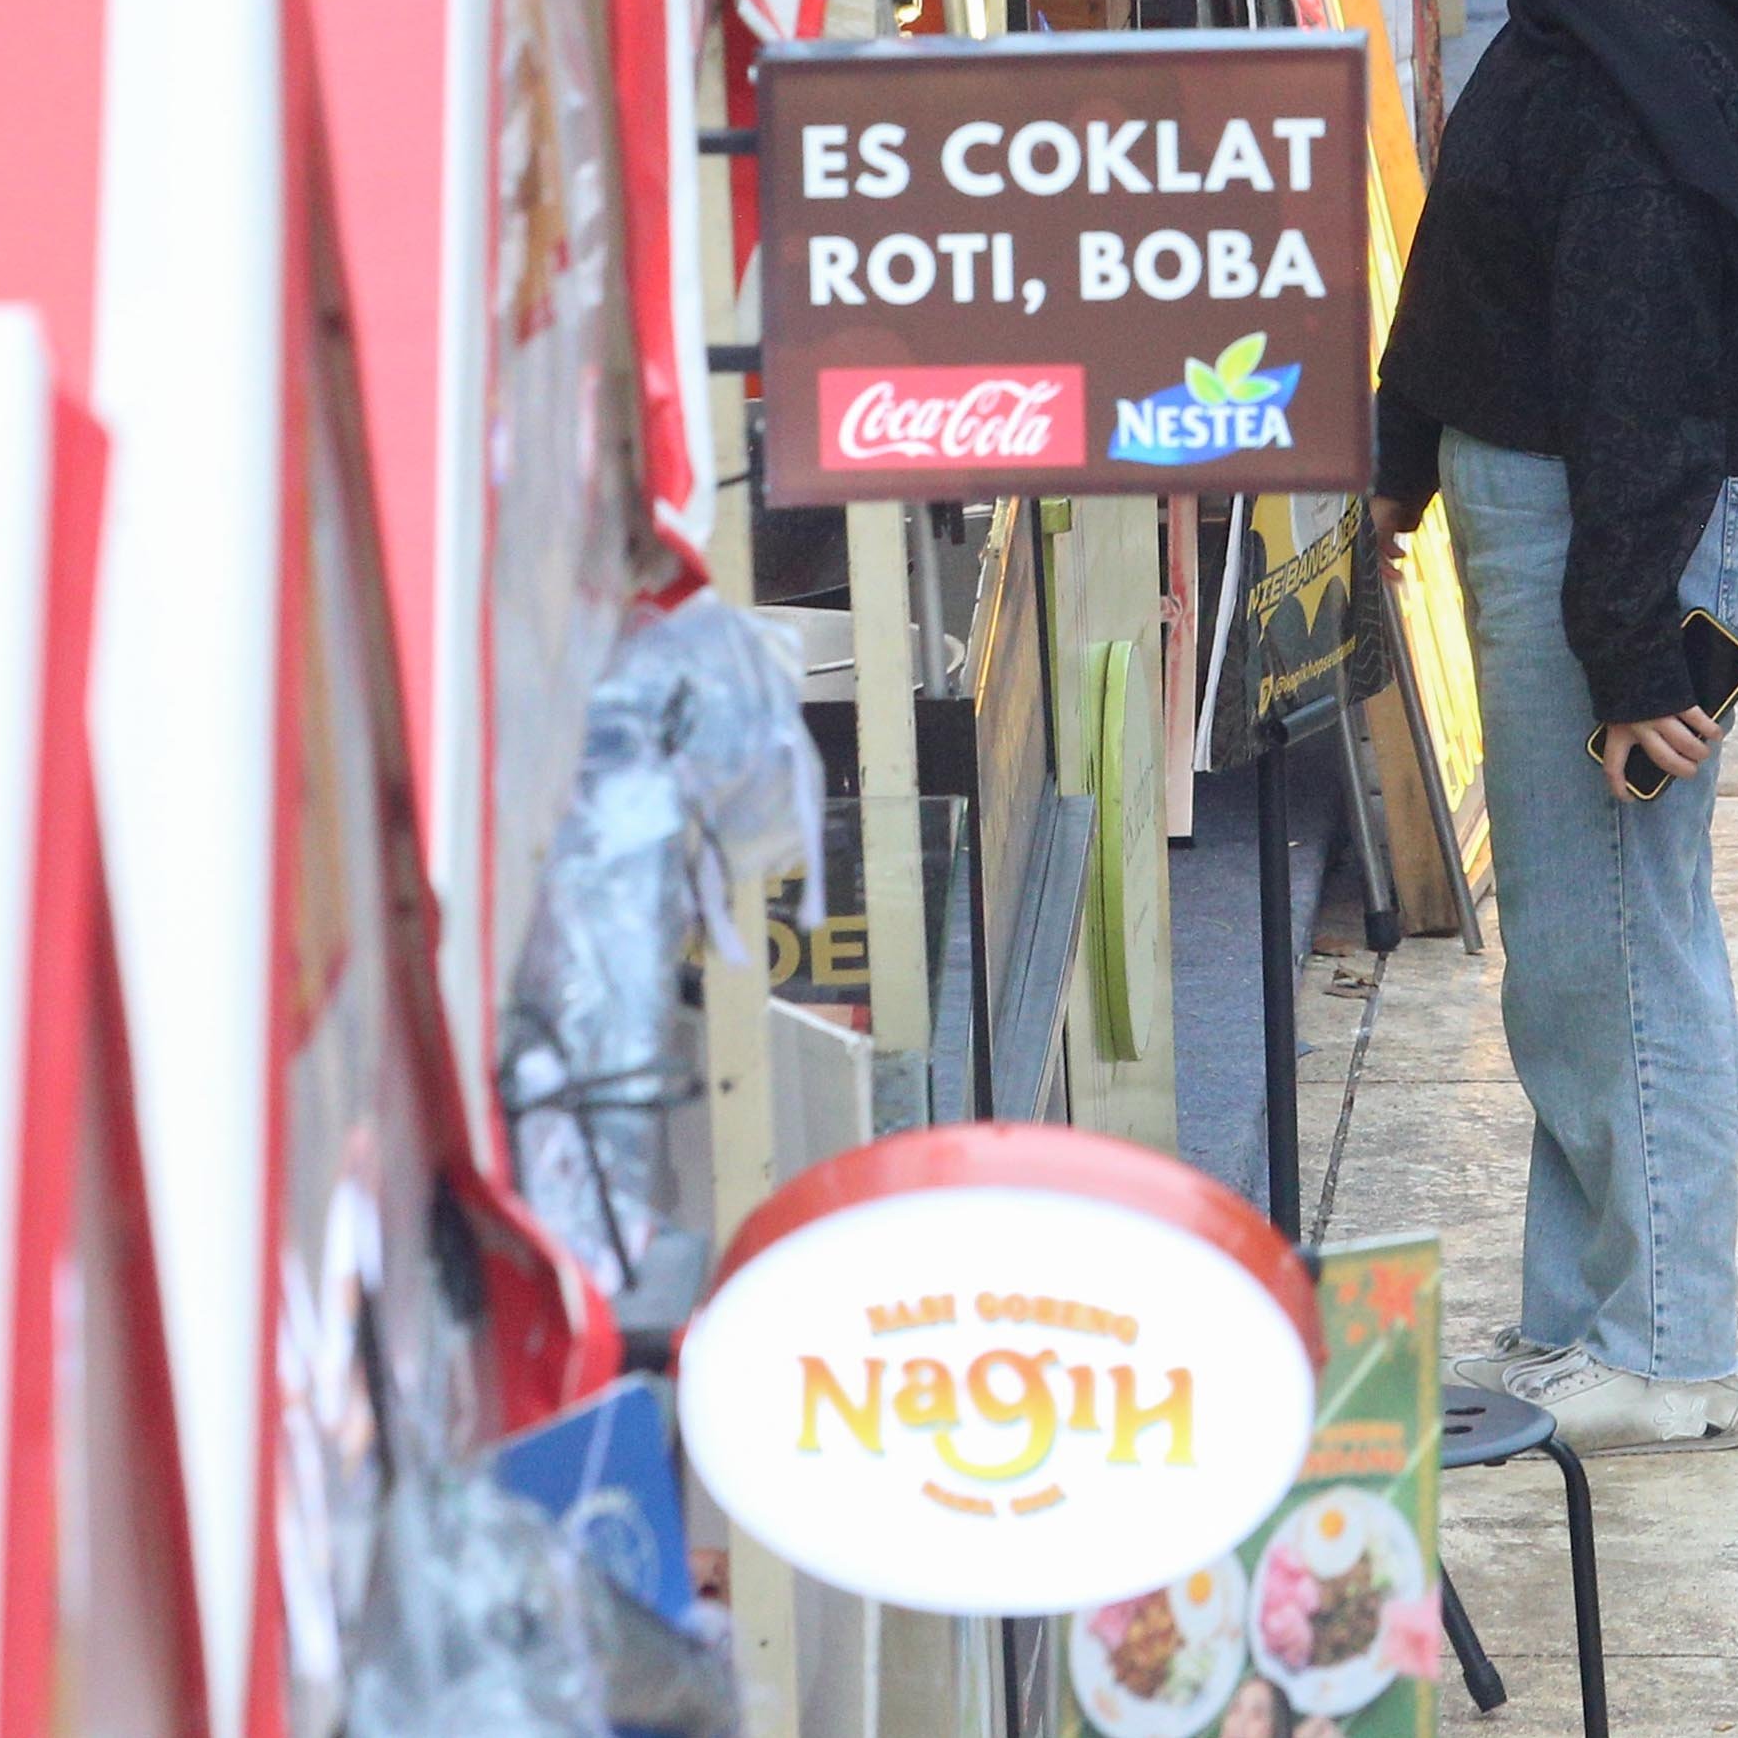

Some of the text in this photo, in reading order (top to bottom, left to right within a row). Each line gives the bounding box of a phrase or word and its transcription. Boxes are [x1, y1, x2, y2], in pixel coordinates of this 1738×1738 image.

[801, 118, 1326, 199] ES COKLAT
[809, 228, 1326, 315] ROTI, BOBA
[837, 378, 1064, 459] Coca-Cola
